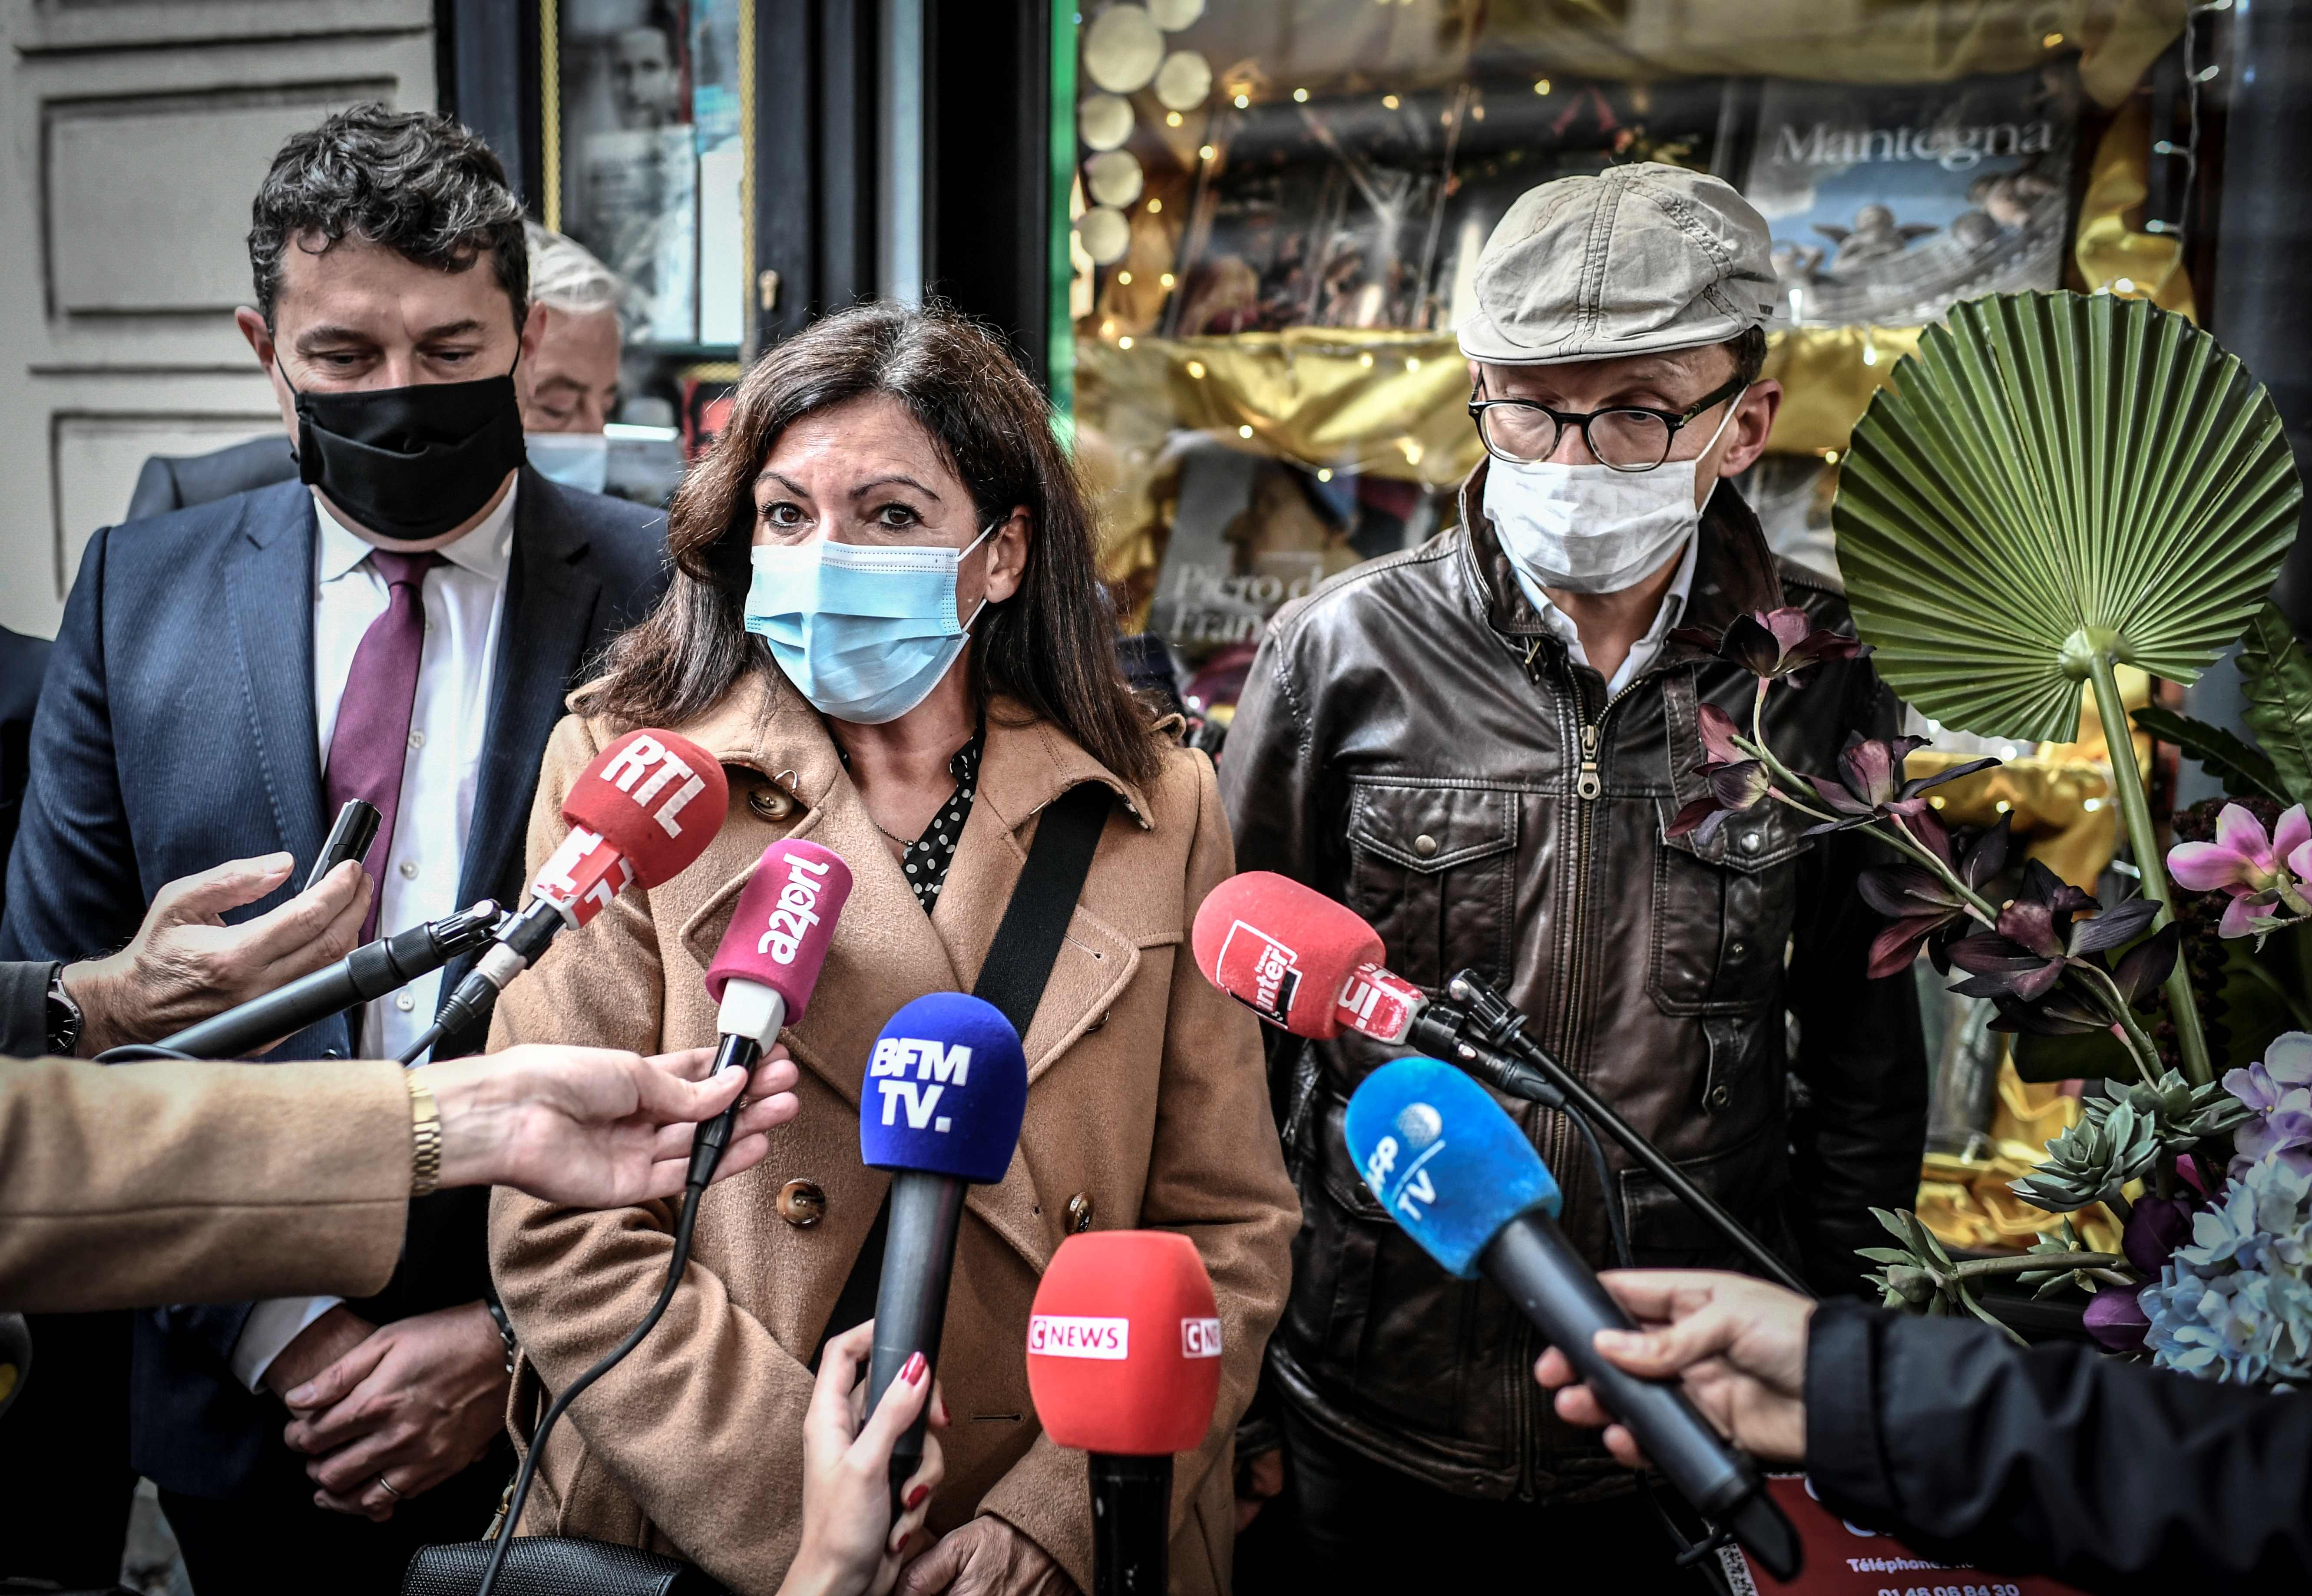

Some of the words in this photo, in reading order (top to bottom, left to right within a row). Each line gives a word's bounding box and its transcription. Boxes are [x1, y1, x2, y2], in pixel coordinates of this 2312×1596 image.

[1773, 121, 2053, 172] Mantegna
[599, 734, 706, 839] RTL
[1254, 944, 1273, 974] france
[1256, 947, 1288, 1012] inter
[870, 1038, 973, 1087] BFM
[1396, 1168, 1437, 1222] TV
[1992, 1584, 2020, 1596] 30
